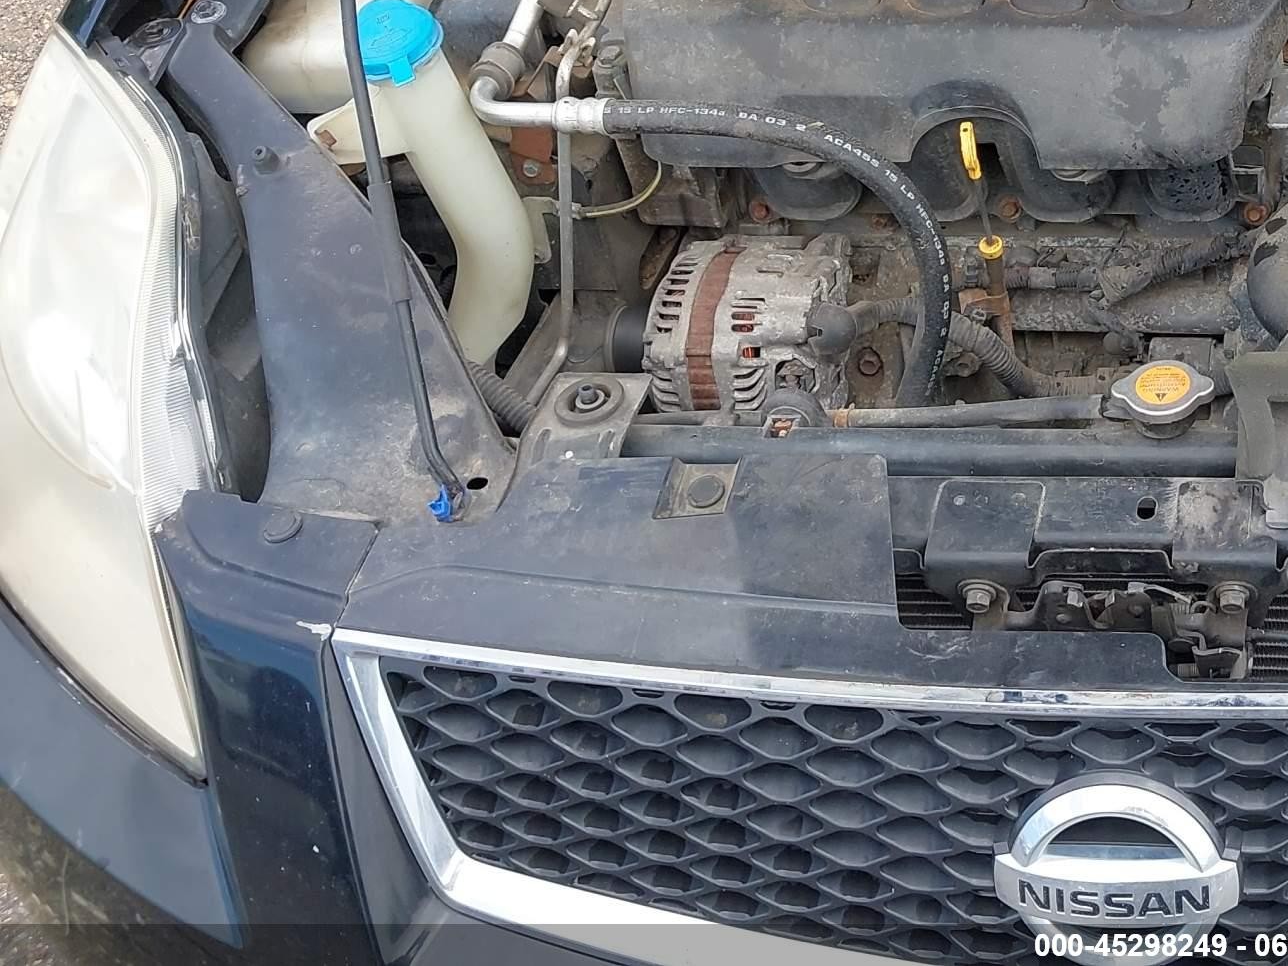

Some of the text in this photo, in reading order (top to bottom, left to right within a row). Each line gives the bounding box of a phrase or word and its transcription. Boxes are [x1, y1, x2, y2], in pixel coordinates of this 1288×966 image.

[637, 106, 654, 114] LP
[659, 106, 726, 117] HFC-134a
[765, 116, 786, 126] 03
[900, 184, 915, 201] LP
[1018, 878, 1211, 918] NISSAN
